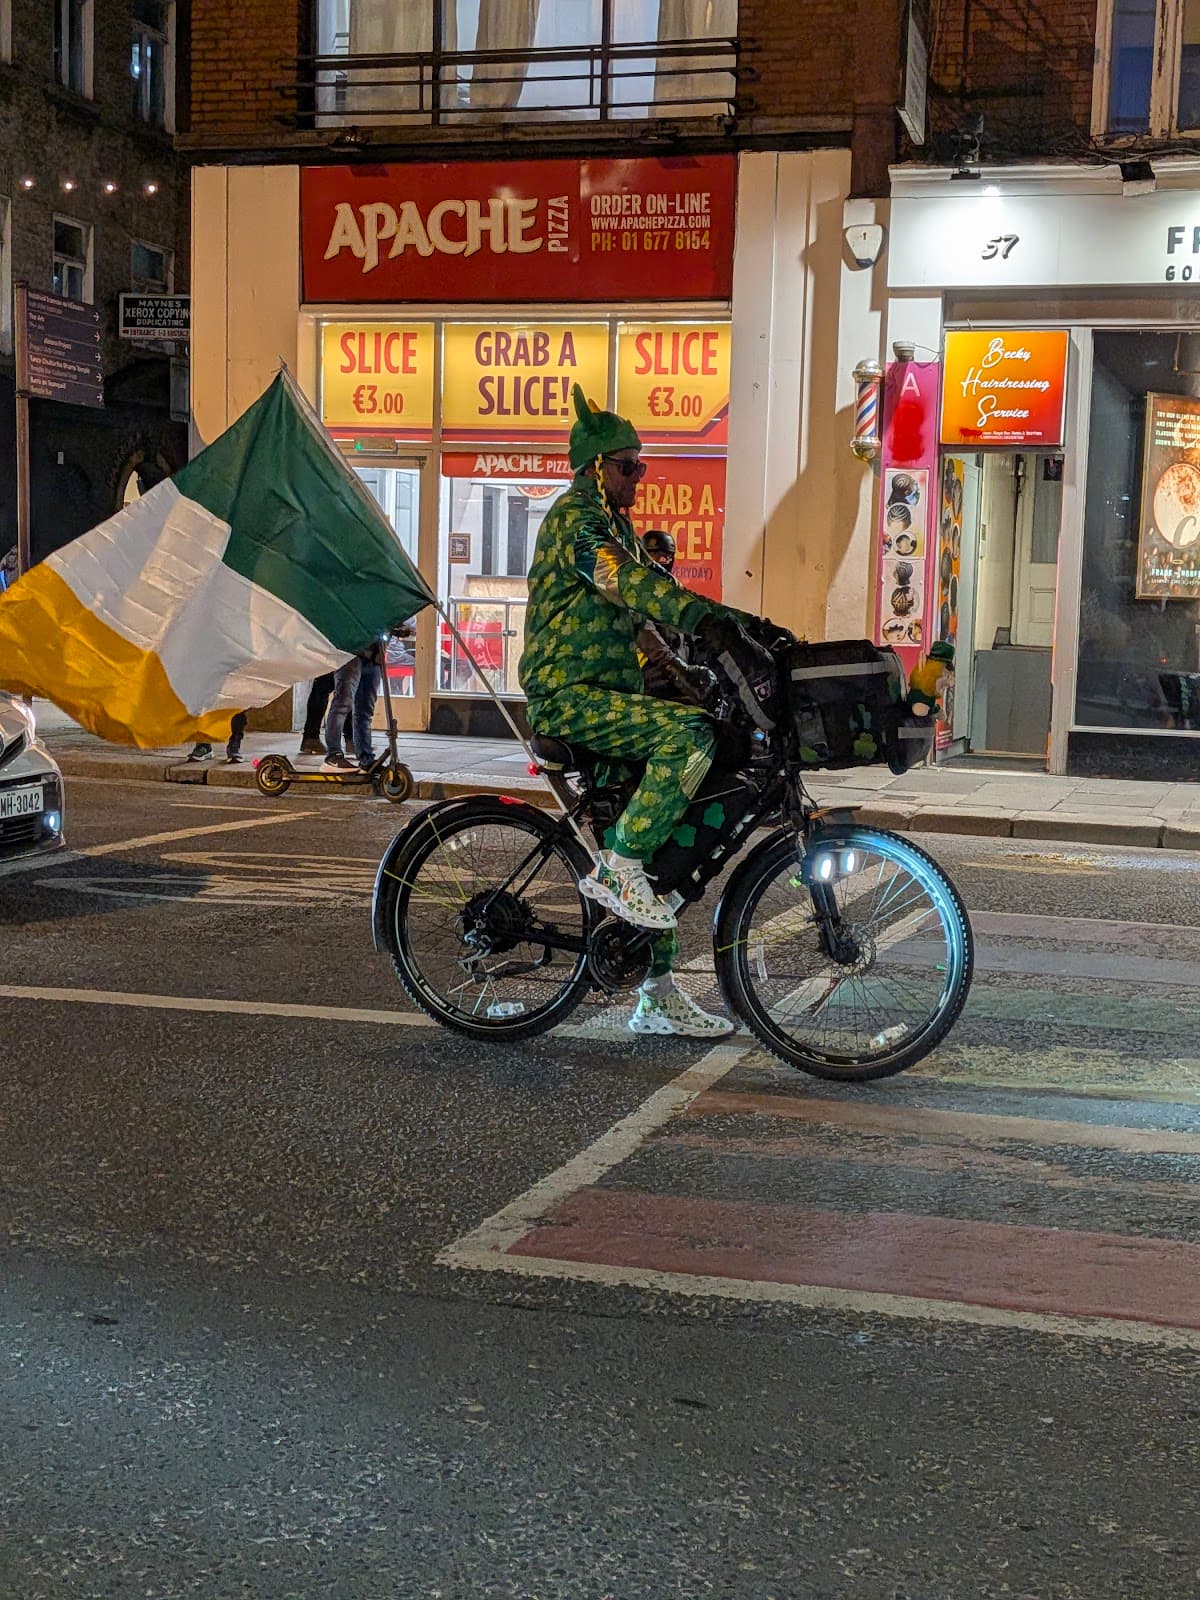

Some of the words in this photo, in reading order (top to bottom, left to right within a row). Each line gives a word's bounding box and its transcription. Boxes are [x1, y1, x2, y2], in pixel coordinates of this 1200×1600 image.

[590, 195, 642, 216] ORDER
[646, 192, 711, 214] ON-LINE
[324, 197, 544, 274] APACHE
[548, 196, 569, 252] PIZZA
[591, 215, 711, 230] WWW.APACHEPIZZA.COM
[591, 232, 618, 251] PH:
[622, 231, 639, 251] 01
[643, 231, 671, 250] 677
[675, 230, 711, 250] 8154
[981, 234, 1020, 260] 57
[125, 307, 155, 319] XEROX
[157, 308, 191, 319] COPYIN
[339, 331, 418, 374] SLICE
[474, 331, 550, 367] GRAB
[557, 331, 577, 367] A
[635, 332, 718, 376] SLICE
[981, 337, 1032, 369] Becky
[478, 375, 571, 416] SLICE!
[900, 372, 920, 397] A
[960, 367, 1050, 398] Hairdressing
[352, 384, 404, 415] €3.00
[647, 386, 703, 417] €3.00
[976, 394, 1030, 427] Service
[473, 454, 544, 477] APACHE
[546, 460, 572, 474] PIZZ
[632, 483, 693, 515] GRAB
[698, 484, 715, 516] A
